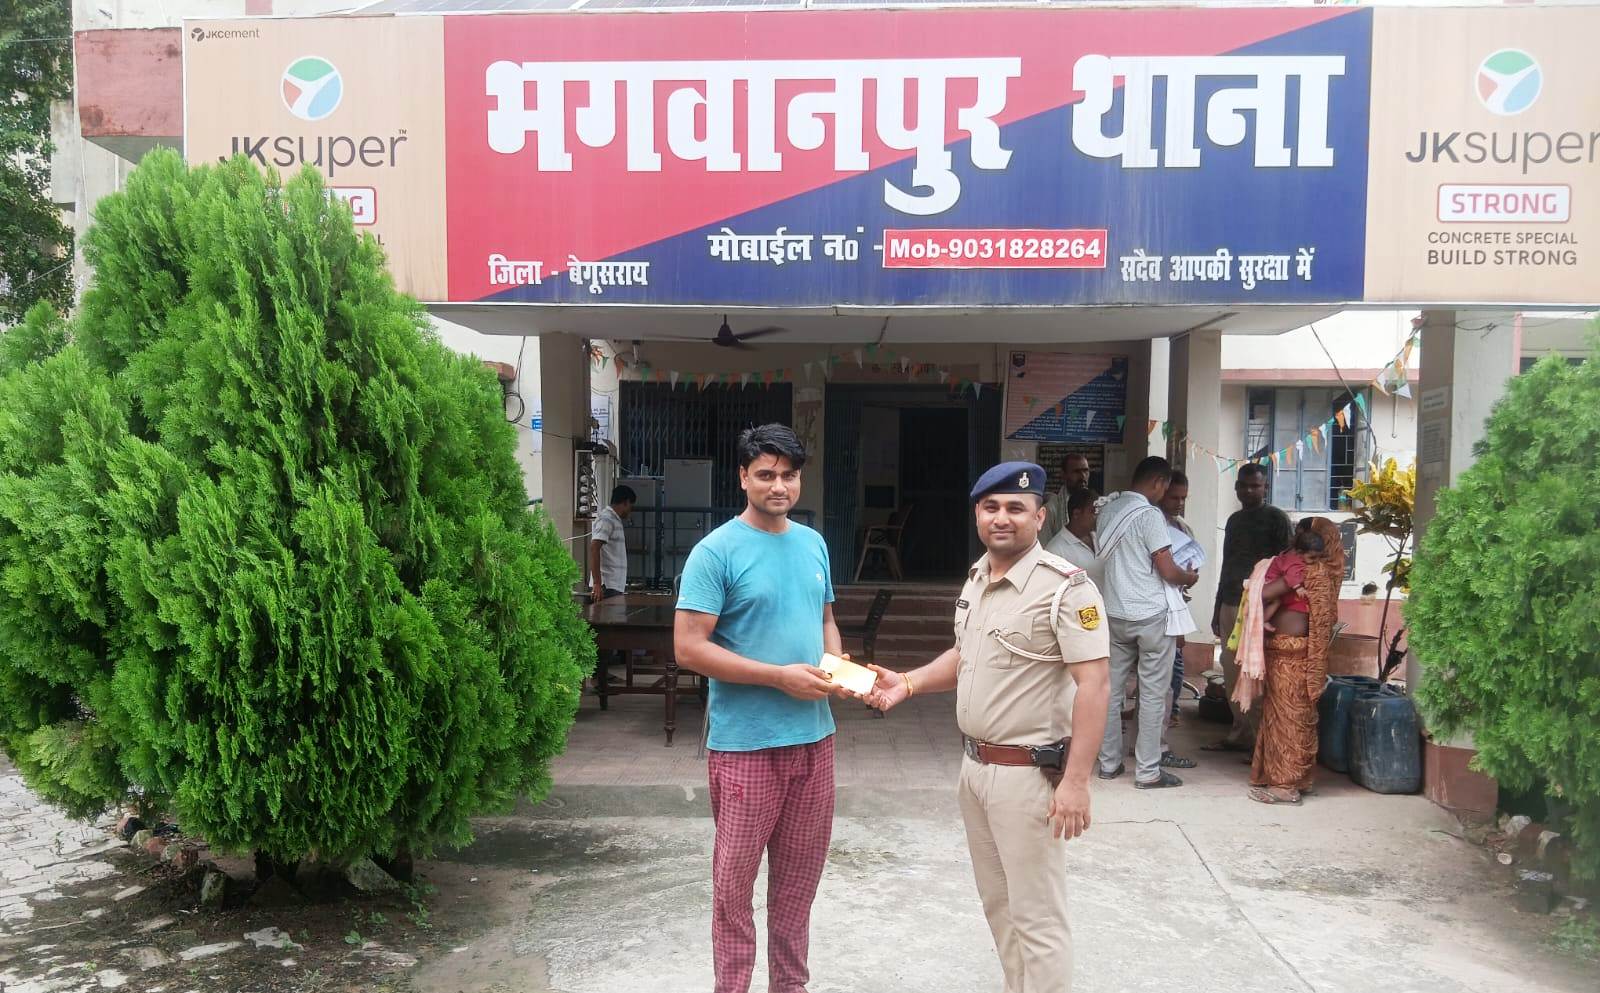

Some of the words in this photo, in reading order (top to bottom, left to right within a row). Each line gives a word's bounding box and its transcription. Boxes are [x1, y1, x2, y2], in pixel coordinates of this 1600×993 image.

[485, 57, 1022, 215] भगवानपुर
[1072, 53, 1346, 168] थाना
[1452, 193, 1557, 214] STRONG
[707, 227, 814, 265] मोबाईल
[890, 238, 1101, 260] Mob-9031828264
[1427, 231, 1512, 244] CONCRETE
[1515, 231, 1578, 245] SPECIAL
[1120, 249, 1161, 282] सदैव
[1169, 248, 1232, 281] आपकी
[1239, 255, 1290, 290] सुरक्षा
[1296, 247, 1316, 281] में
[1427, 249, 1487, 265] BUILD
[1493, 250, 1577, 266] STRONG
[488, 254, 543, 286] जिला
[567, 255, 650, 294] बेगूसराय
